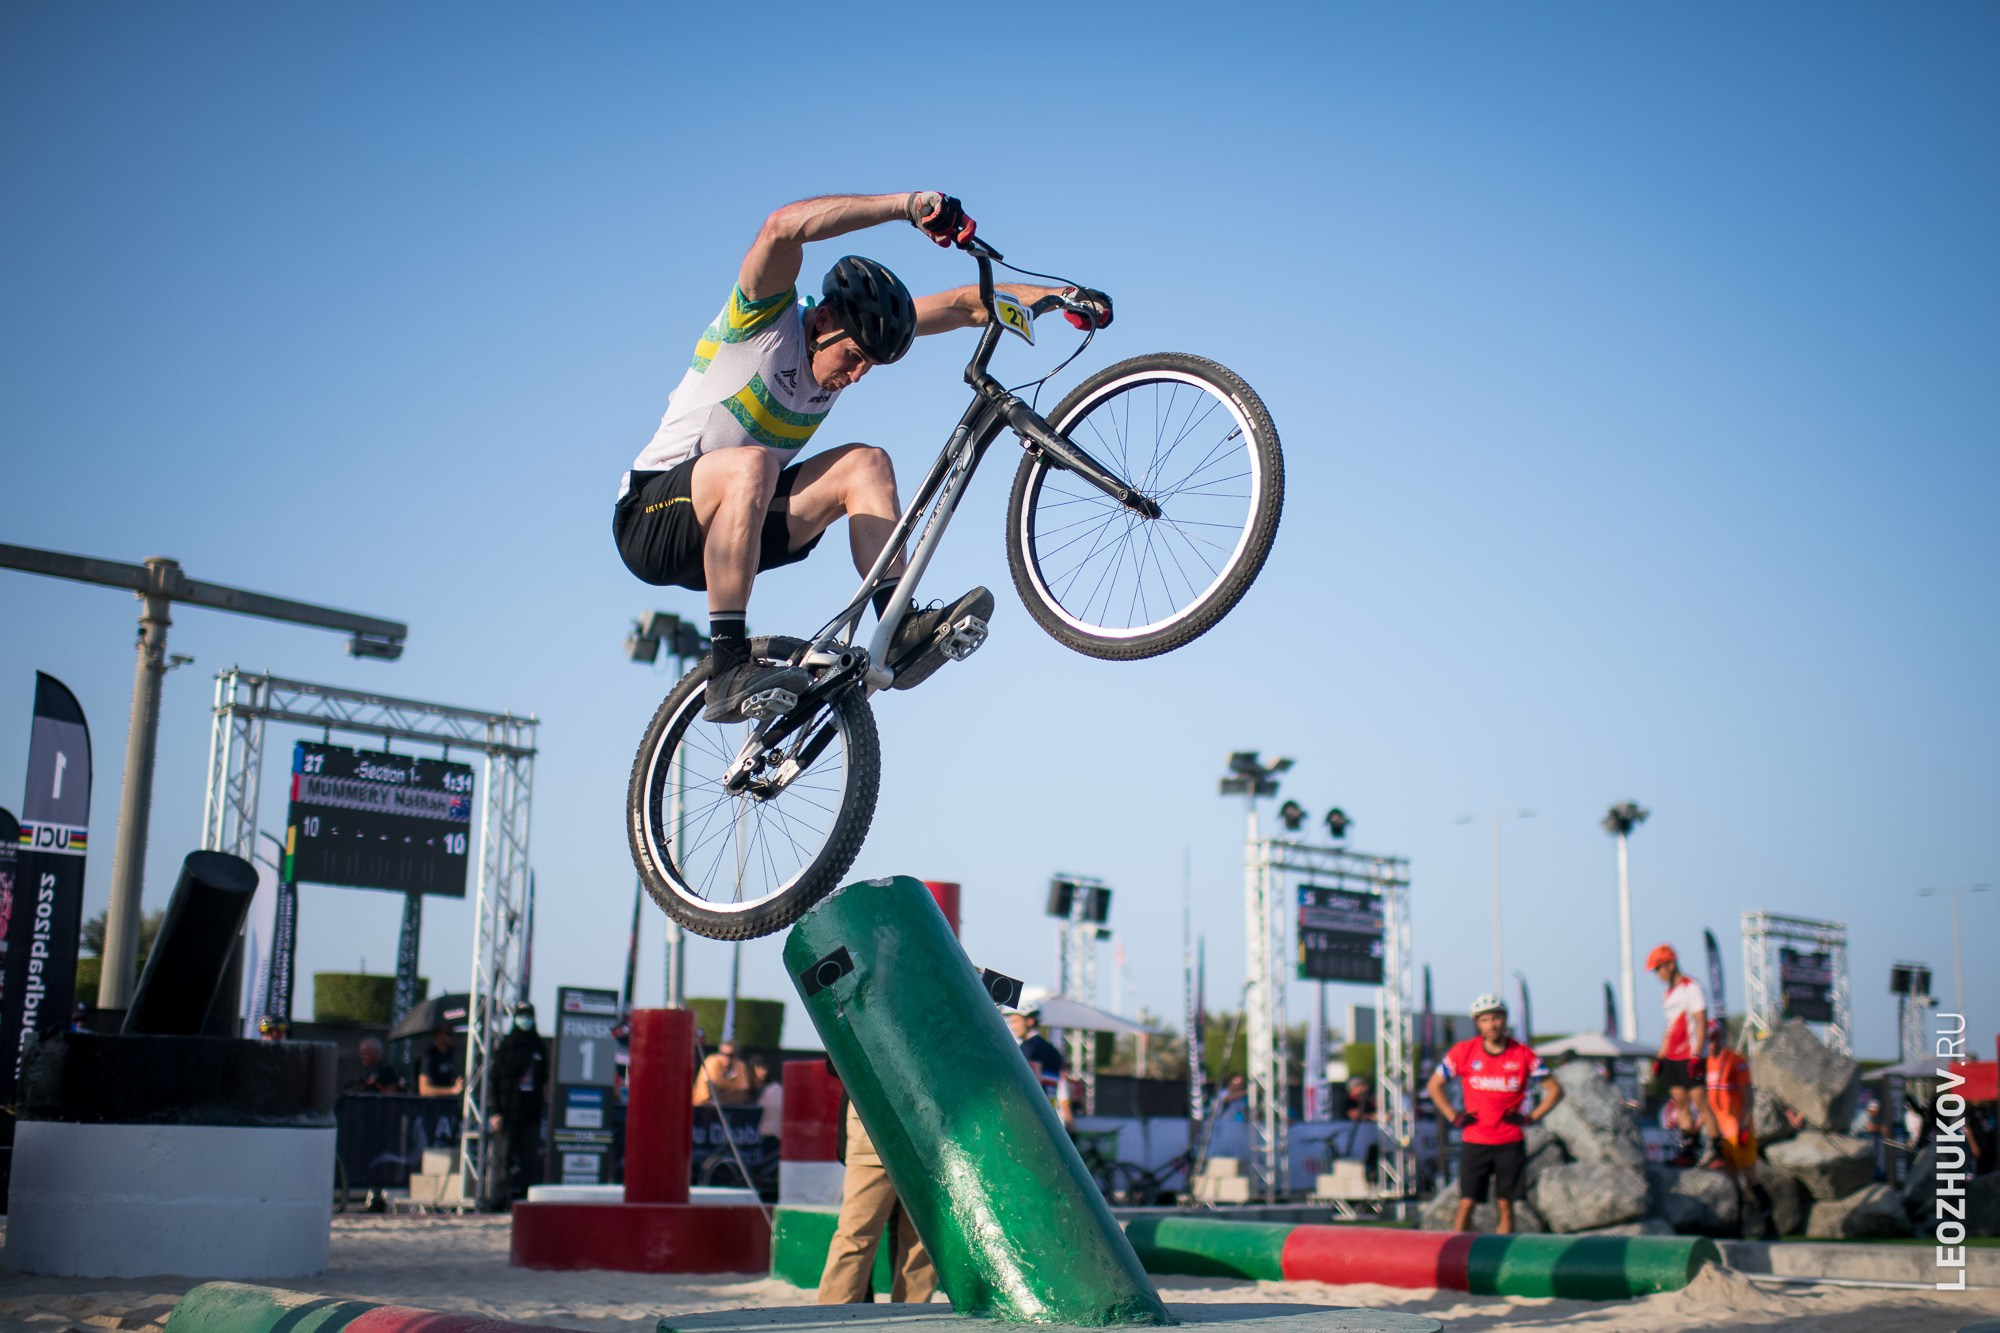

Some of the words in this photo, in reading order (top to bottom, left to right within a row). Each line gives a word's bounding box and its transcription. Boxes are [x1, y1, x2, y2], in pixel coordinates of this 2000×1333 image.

[1007, 306, 1024, 331] 27
[303, 754, 325, 773] 27
[308, 779, 390, 804] MUMMERY
[303, 816, 320, 838] 10
[444, 833, 466, 855] 10
[579, 1040, 595, 1081] 1
